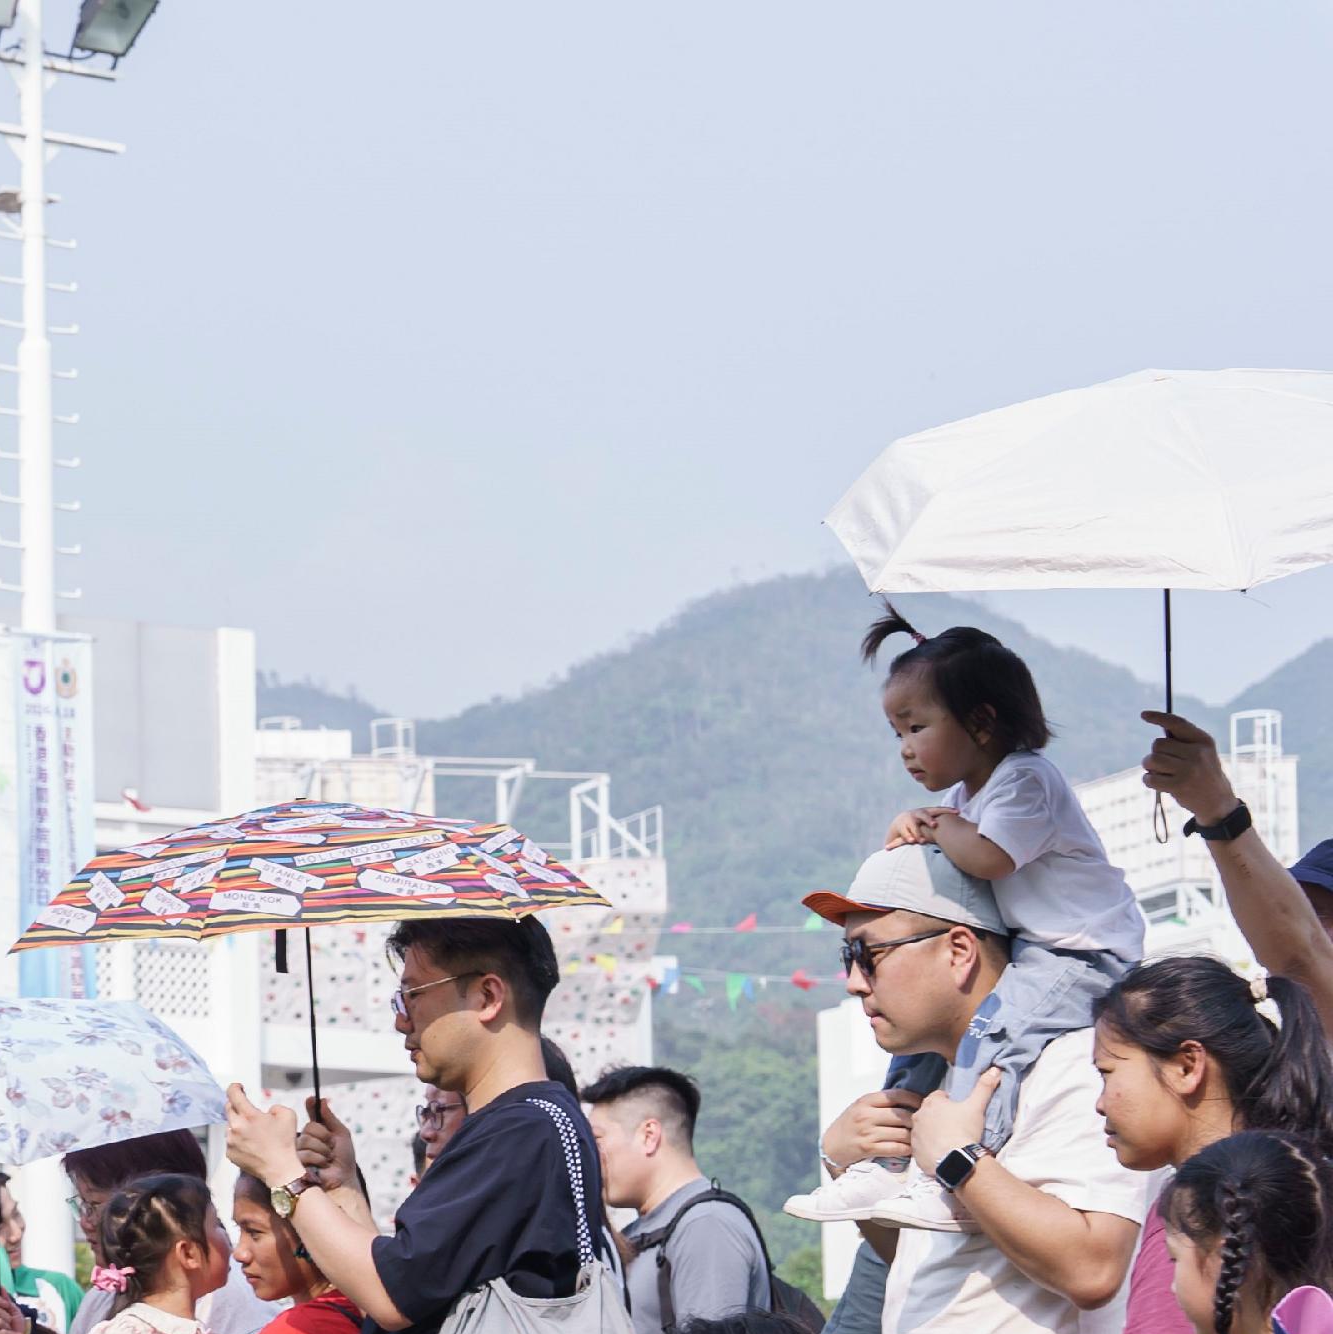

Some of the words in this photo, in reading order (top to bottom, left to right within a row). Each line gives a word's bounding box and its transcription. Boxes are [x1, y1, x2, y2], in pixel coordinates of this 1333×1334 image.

[295, 841, 390, 864] HOLLYWOOD
[400, 833, 441, 846] ROAD
[262, 863, 312, 884] STANLEY
[375, 874, 439, 892] ADMIRALTY
[223, 893, 256, 901] MONG
[260, 896, 283, 904] KOK
